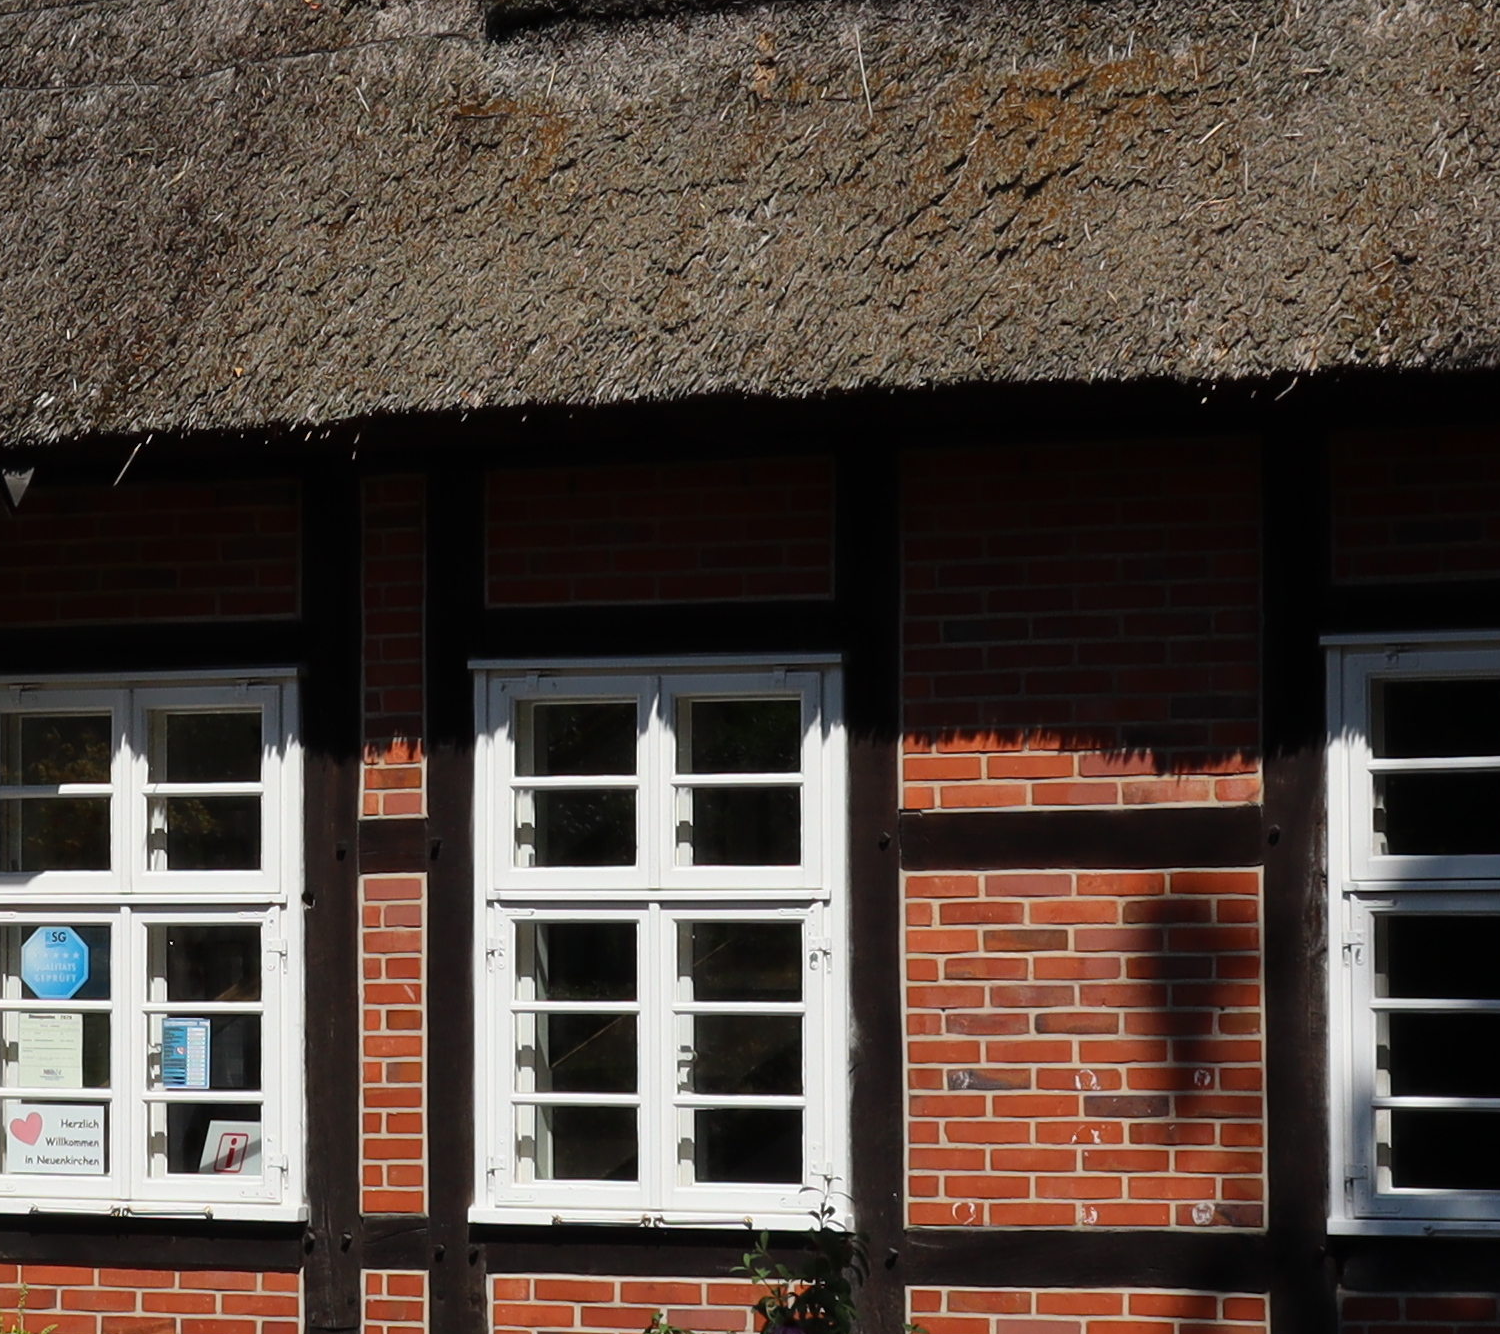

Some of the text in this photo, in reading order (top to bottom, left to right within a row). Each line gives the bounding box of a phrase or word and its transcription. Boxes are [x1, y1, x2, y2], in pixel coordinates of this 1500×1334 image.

[60, 1118, 99, 1129] Herzlich
[45, 1136, 100, 1147] Willkommen
[36, 1155, 100, 1166] Neuenkirchen
